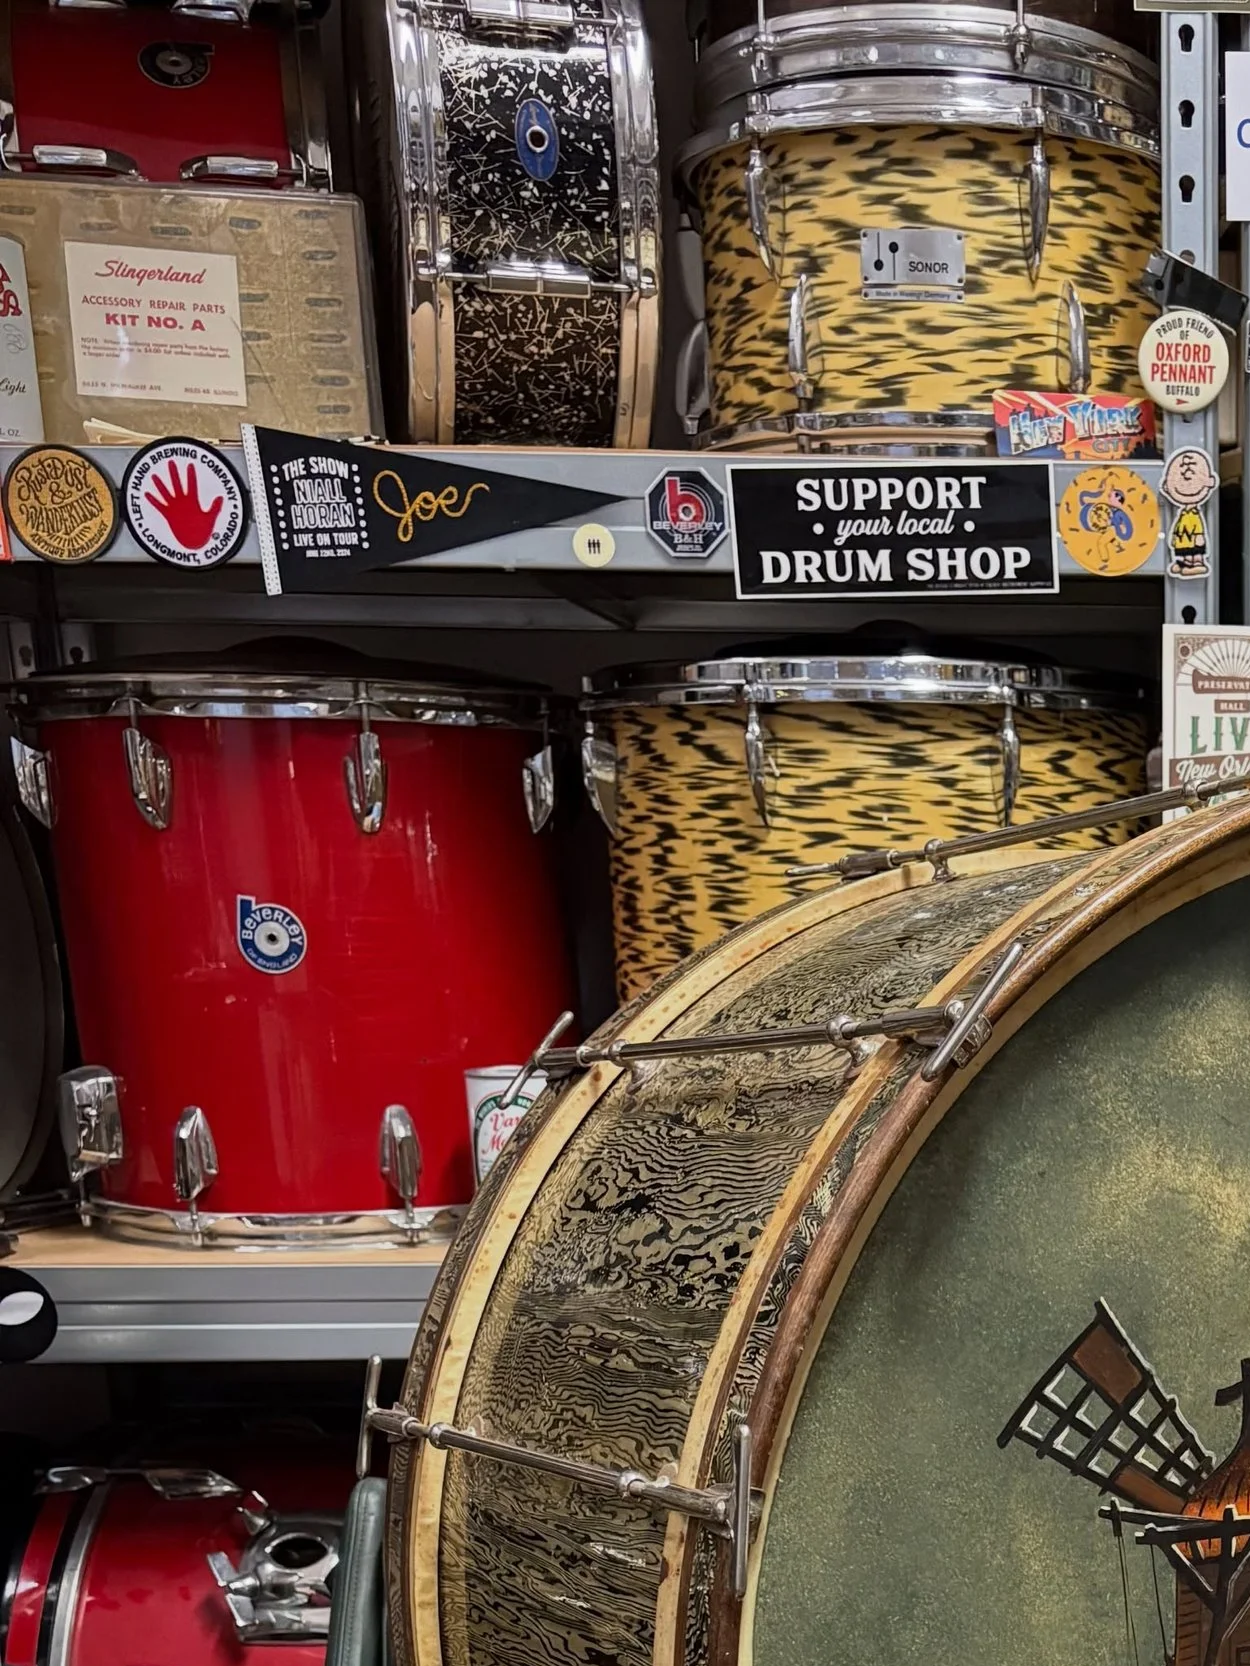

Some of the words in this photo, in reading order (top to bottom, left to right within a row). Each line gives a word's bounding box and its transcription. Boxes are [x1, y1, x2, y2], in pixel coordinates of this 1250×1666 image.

[95, 260, 207, 286] Slingerland
[908, 261, 949, 273] SONOR
[82, 295, 142, 308] ACCESSORY
[150, 300, 186, 311] REPAIR
[193, 303, 226, 314] PARTS
[105, 313, 139, 326] KIT
[147, 316, 184, 329] NO.
[191, 319, 206, 331] A
[1156, 318, 1183, 337] PROUD
[1186, 318, 1215, 339] FRIEND
[1180, 330, 1190, 340] OF
[1156, 342, 1211, 363] OXFORD
[1151, 363, 1216, 384] PENNANT
[1166, 385, 1200, 397] BUFFALO
[150, 447, 197, 464] BREWING
[1092, 438, 1131, 454] CITY
[131, 462, 151, 491] HAND
[201, 454, 238, 501] COMPANY
[282, 458, 307, 481] THE
[309, 456, 349, 479] SHOW
[49, 481, 73, 505] &
[293, 478, 347, 504] NIALL
[796, 477, 987, 511] SUPPORT
[131, 493, 144, 522] LEFT
[291, 503, 355, 529] HORAN
[373, 470, 490, 542] Joe
[653, 521, 723, 531] BEVERLEY
[834, 517, 893, 546] your
[896, 510, 955, 535] local
[142, 528, 201, 564] LONGMONT,
[204, 511, 239, 559] COLORADO
[293, 533, 315, 552] LIVE
[316, 533, 331, 551] ON
[332, 532, 359, 550] TOUR
[759, 549, 893, 584] DRUM
[906, 547, 1031, 581] SHOP
[1220, 702, 1246, 711] HALL
[1176, 757, 1216, 781] New
[257, 953, 298, 968] ENGLAND
